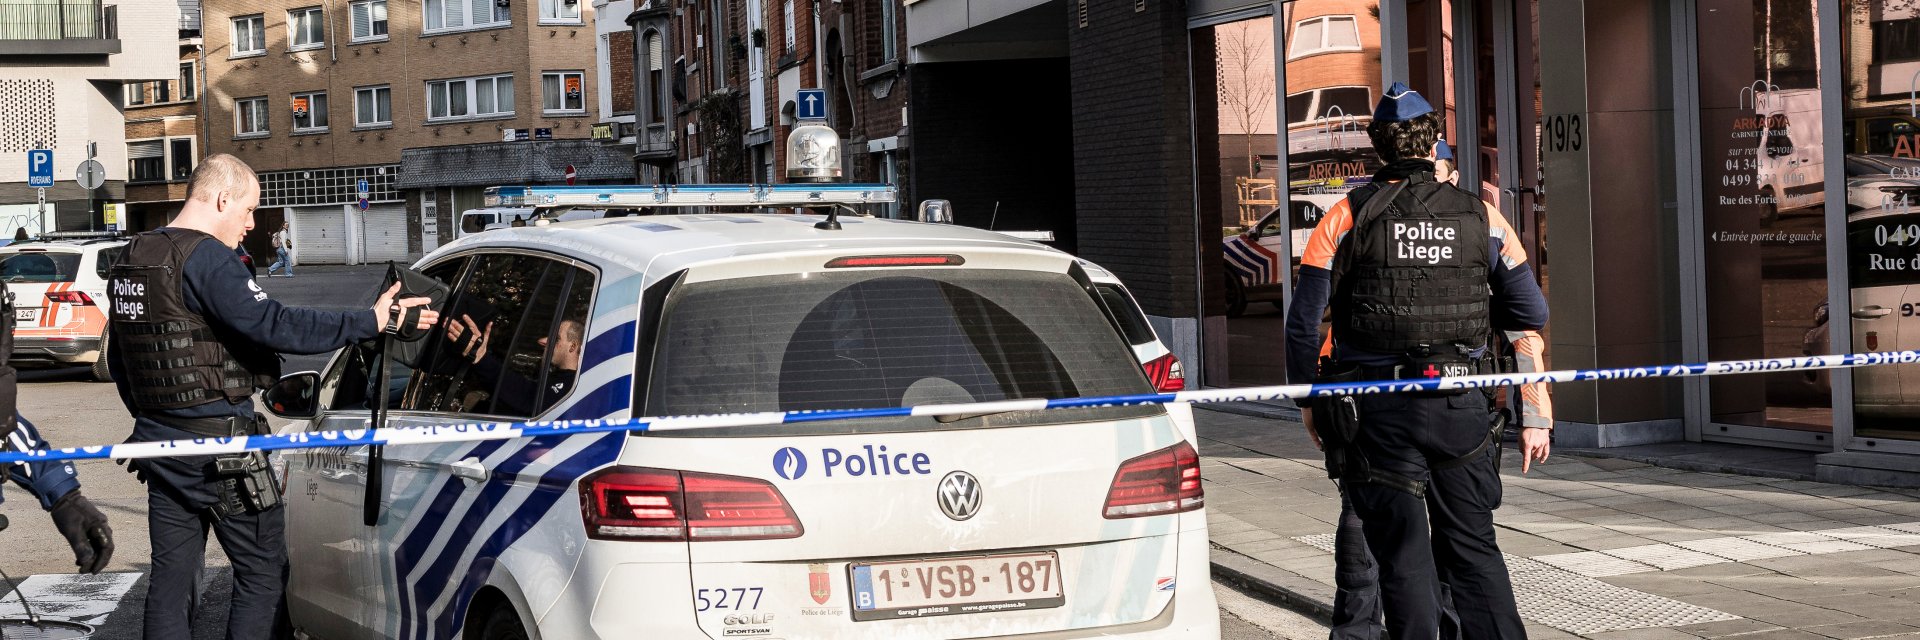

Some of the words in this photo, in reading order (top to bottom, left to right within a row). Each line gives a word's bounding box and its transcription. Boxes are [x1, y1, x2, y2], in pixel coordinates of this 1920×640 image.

[1733, 115, 1791, 130] ARKADYA
[593, 125, 612, 139] HOTEL
[1545, 114, 1582, 152] 19/3
[1731, 130, 1759, 139] CABINET
[1760, 129, 1791, 137] DNTAIR
[1728, 147, 1743, 156] sur
[1744, 146, 1799, 155] renz-vou
[1725, 159, 1739, 170] 04
[1743, 158, 1763, 170] 344
[1308, 162, 1366, 181] ARKADYA
[30, 175, 52, 185] RIVERAINS
[1722, 174, 1751, 187] 0499
[1720, 195, 1737, 205] Rue
[1738, 194, 1753, 205] des
[1881, 193, 1910, 215] 04
[1394, 221, 1456, 240] Police
[1720, 230, 1749, 242] Entrée
[1750, 231, 1774, 244] porte
[1775, 230, 1788, 241] de
[1788, 230, 1823, 243] gauche
[1397, 241, 1453, 265] Liege
[1869, 253, 1906, 270] Rue
[114, 278, 145, 296] Police
[115, 298, 144, 320] Liege
[1443, 365, 1469, 378] MED
[822, 444, 932, 478] Police
[697, 586, 764, 612] 5277
[860, 591, 872, 608] B
[961, 601, 1026, 611] www.garagepaisse.be
[723, 612, 775, 625] GOLF
[897, 608, 918, 616] Garage
